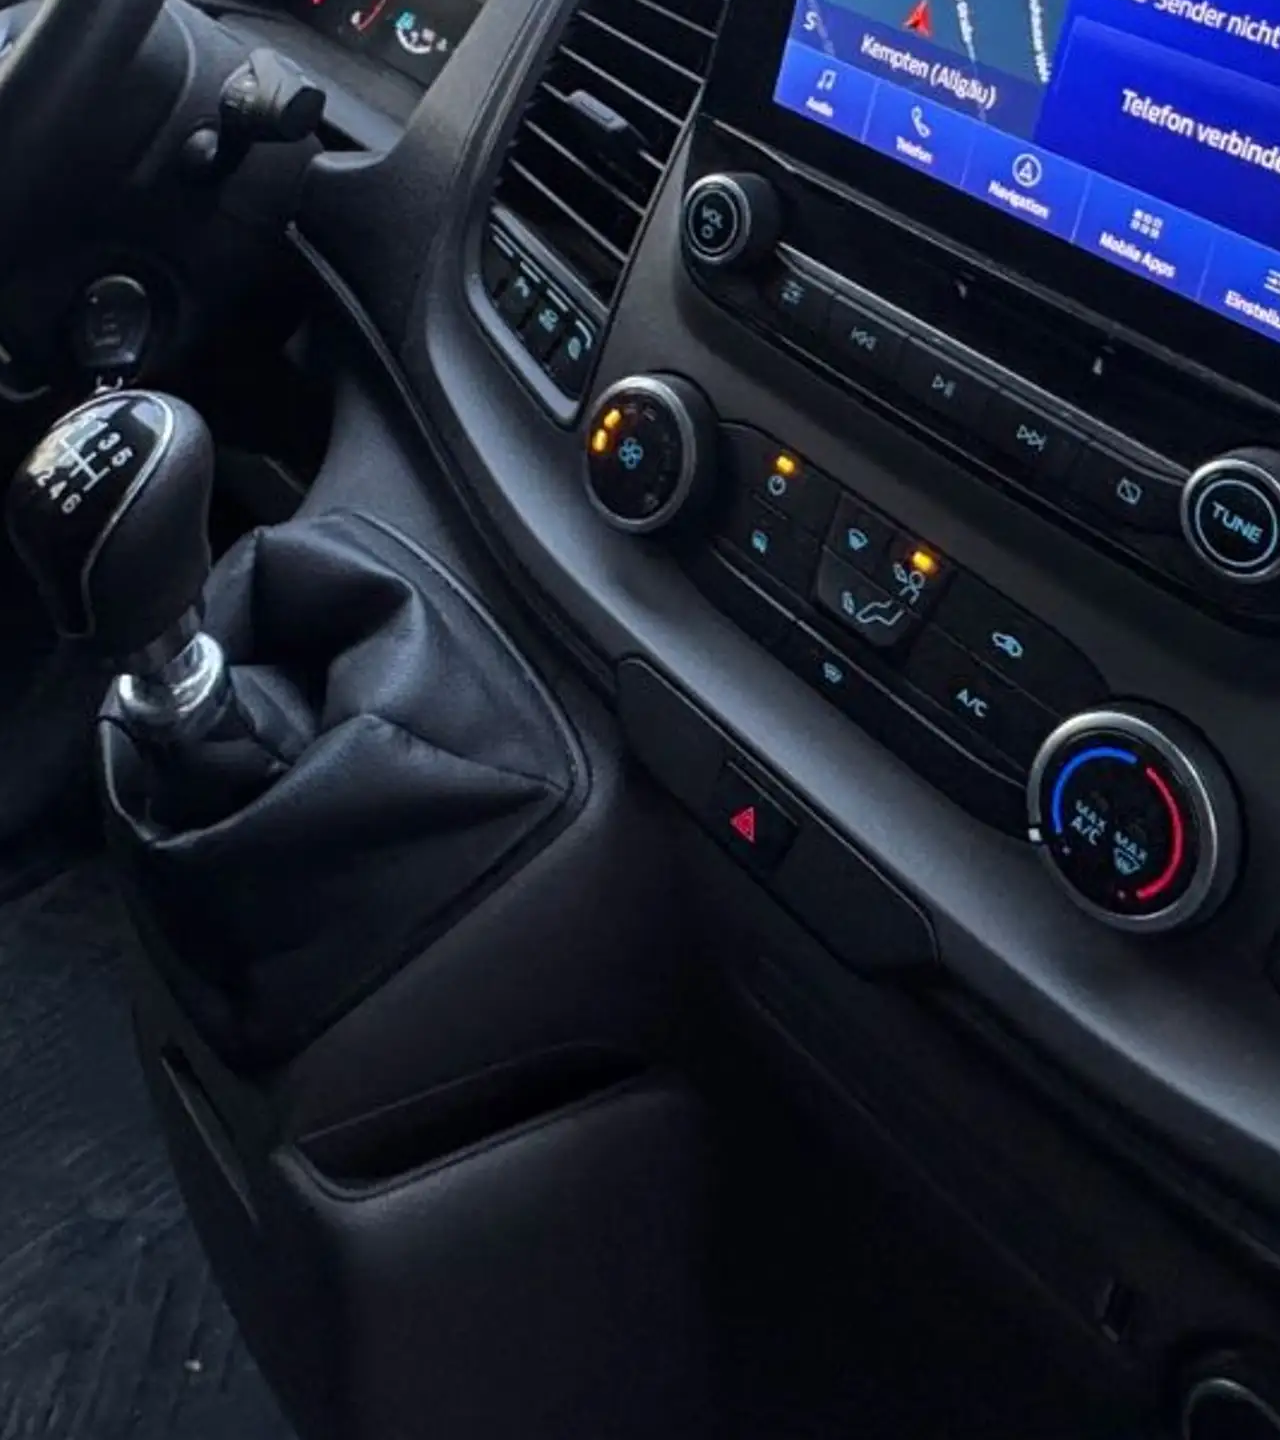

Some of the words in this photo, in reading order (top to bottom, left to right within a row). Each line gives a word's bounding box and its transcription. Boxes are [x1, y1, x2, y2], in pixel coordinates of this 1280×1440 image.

[860, 33, 929, 79] Kempten
[930, 62, 997, 109] (Allgäu)
[1121, 89, 1195, 137] Telefon
[988, 180, 1050, 219] Navigation
[702, 204, 724, 229] VOL
[1099, 232, 1141, 263] Mobile
[1141, 250, 1176, 279] Apps
[98, 432, 120, 451] 3
[111, 447, 132, 467] 5
[36, 467, 55, 487] 2
[49, 480, 67, 500] 4
[62, 493, 82, 513] 6
[1211, 500, 1264, 544] TUNE
[956, 688, 989, 718] A/C
[1069, 815, 1098, 847] A/C
